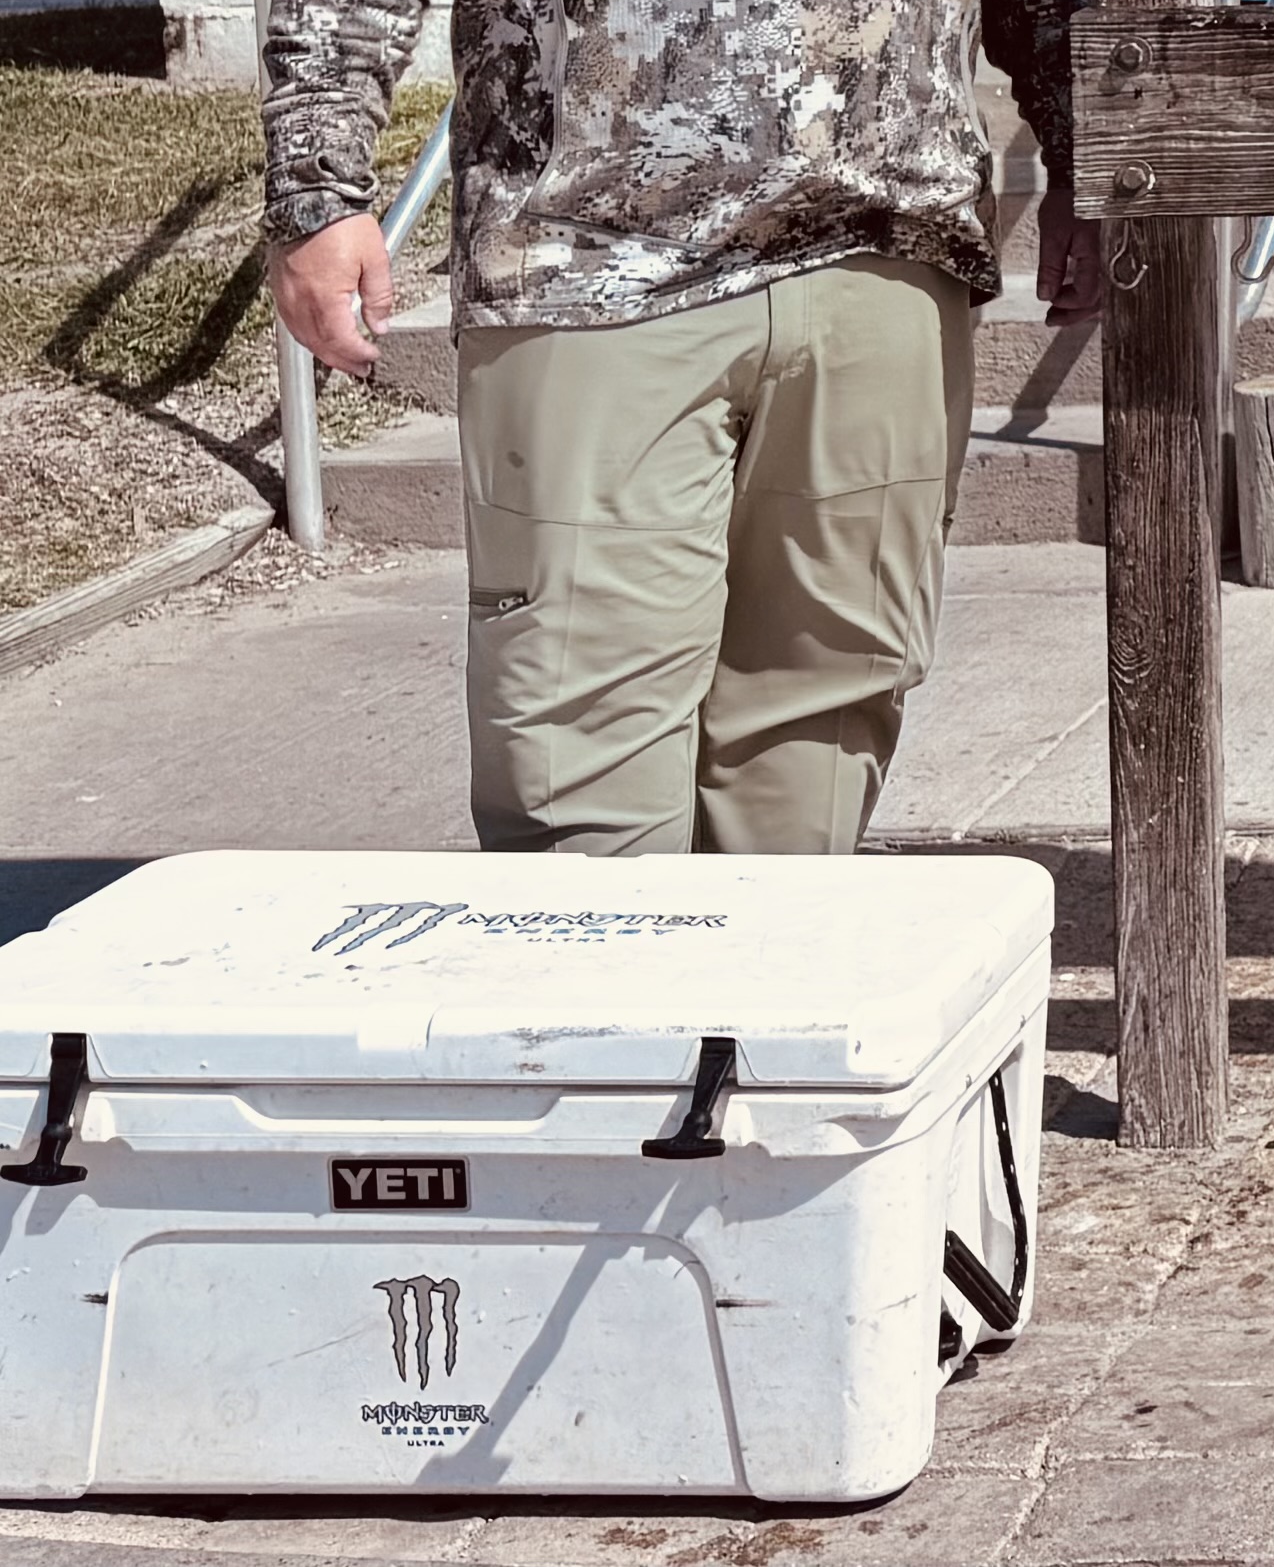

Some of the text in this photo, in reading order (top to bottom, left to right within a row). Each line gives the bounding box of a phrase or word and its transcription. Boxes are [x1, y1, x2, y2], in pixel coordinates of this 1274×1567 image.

[457, 911, 728, 928] MONSTER
[336, 1167, 456, 1201] YETI
[361, 1401, 490, 1426] MONSTER
[381, 1426, 471, 1436] ENERGY
[407, 1440, 445, 1448] ULTRA
